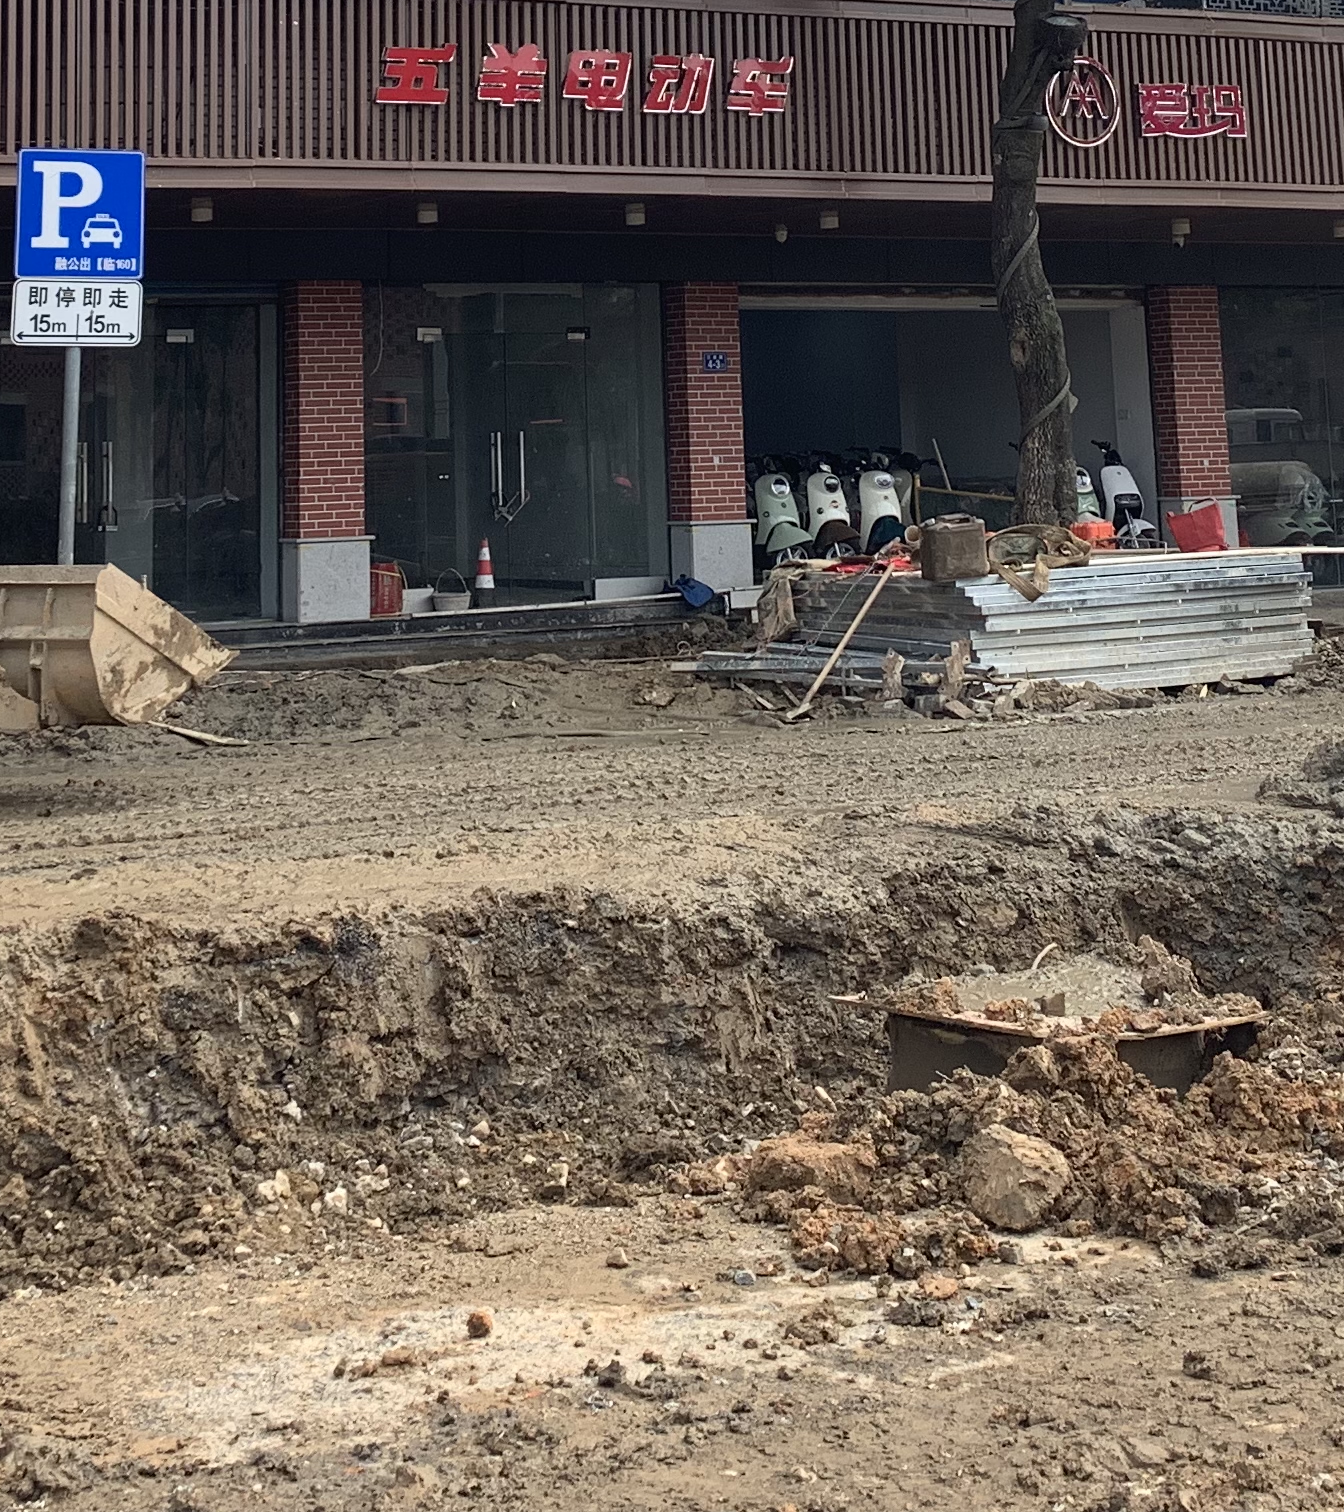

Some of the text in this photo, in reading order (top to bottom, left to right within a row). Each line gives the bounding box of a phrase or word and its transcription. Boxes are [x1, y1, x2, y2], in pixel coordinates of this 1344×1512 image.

[375, 42, 794, 117] 五羊电动车
[1138, 82, 1248, 138] 爱玛
[31, 160, 104, 248] P
[28, 286, 129, 309] 即停即走
[29, 313, 121, 334] 15m 15m
